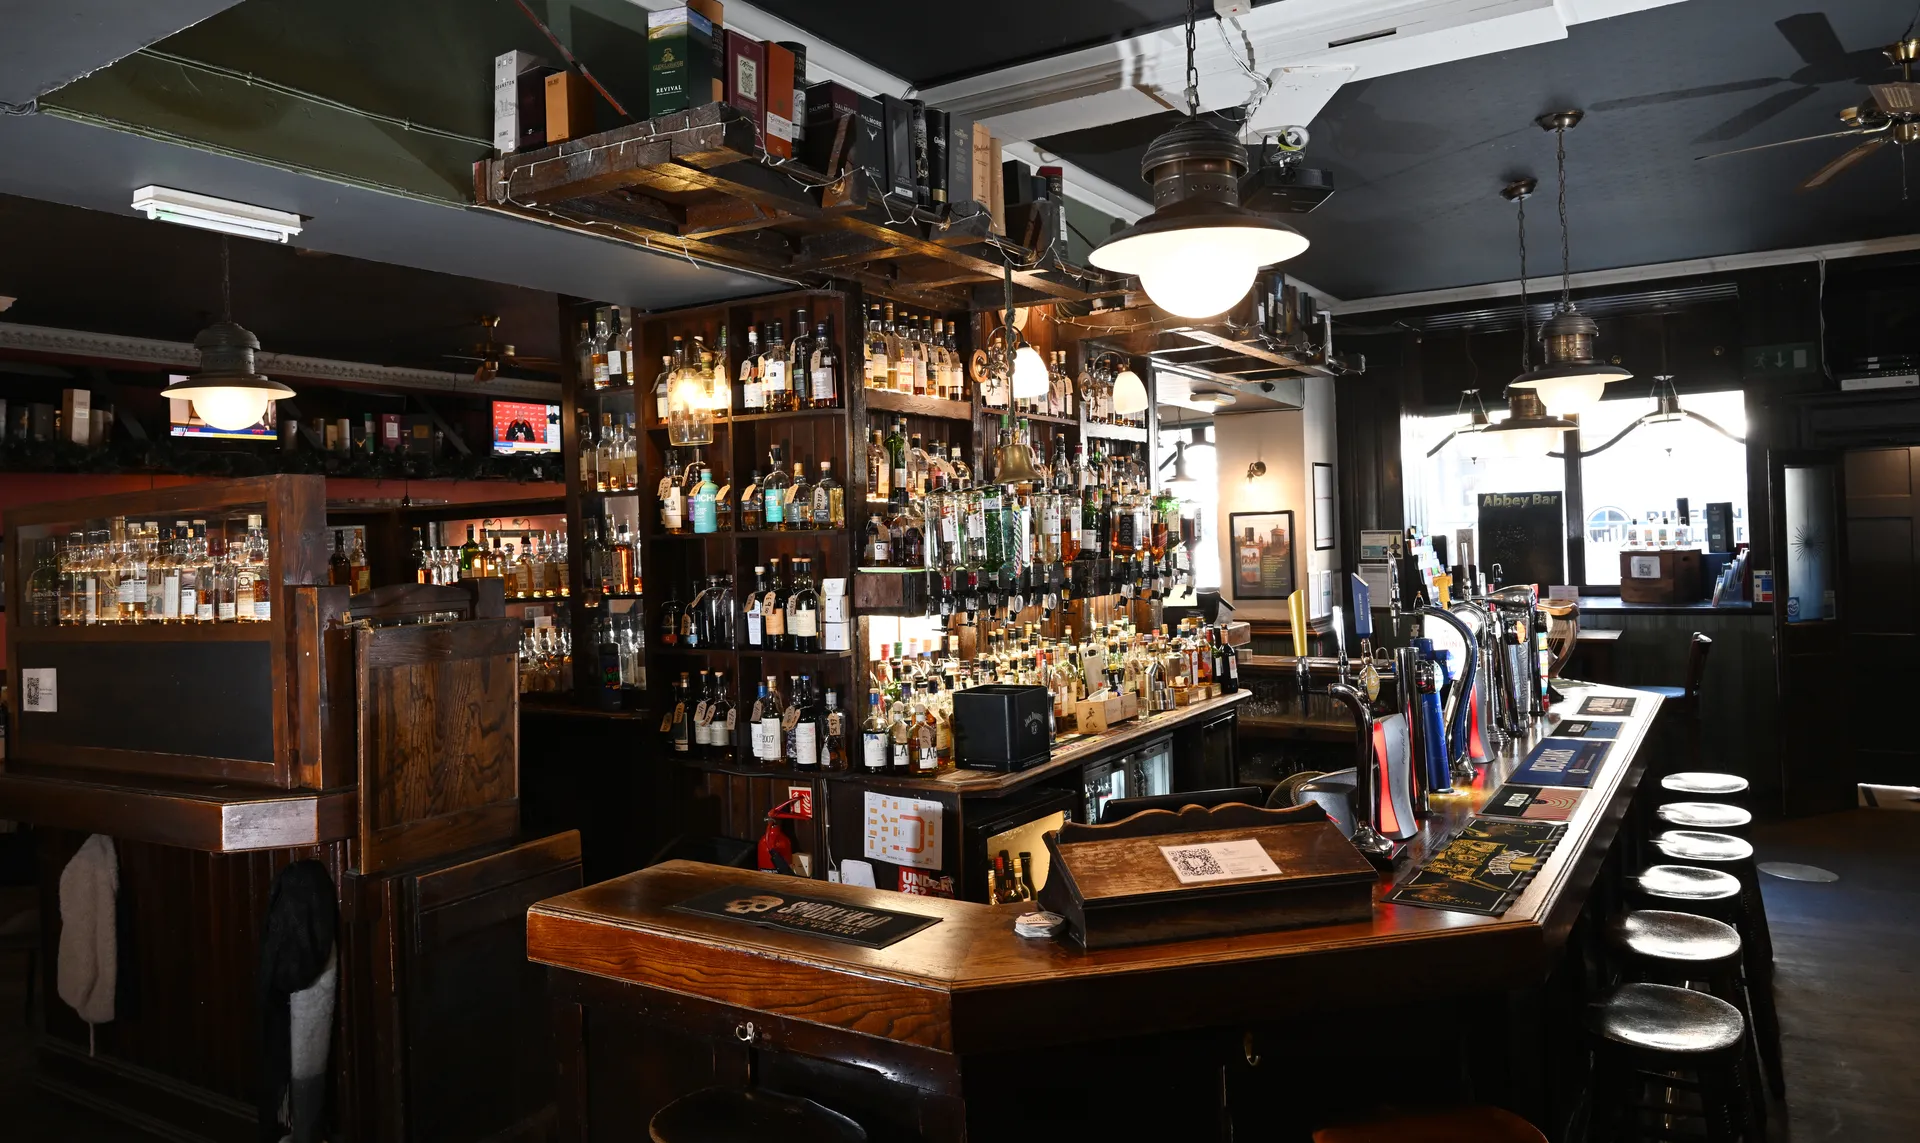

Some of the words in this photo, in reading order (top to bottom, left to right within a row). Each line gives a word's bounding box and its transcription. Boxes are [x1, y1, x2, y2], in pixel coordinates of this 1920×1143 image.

[495, 79, 515, 91] DEANSTON
[656, 85, 683, 94] REVIVAL
[834, 102, 858, 115] DALMORE
[861, 113, 884, 127] DALMORE
[1484, 494, 1529, 507] Abbey
[1533, 494, 1556, 505] Bar
[777, 901, 893, 930] SMOKEHEAD
